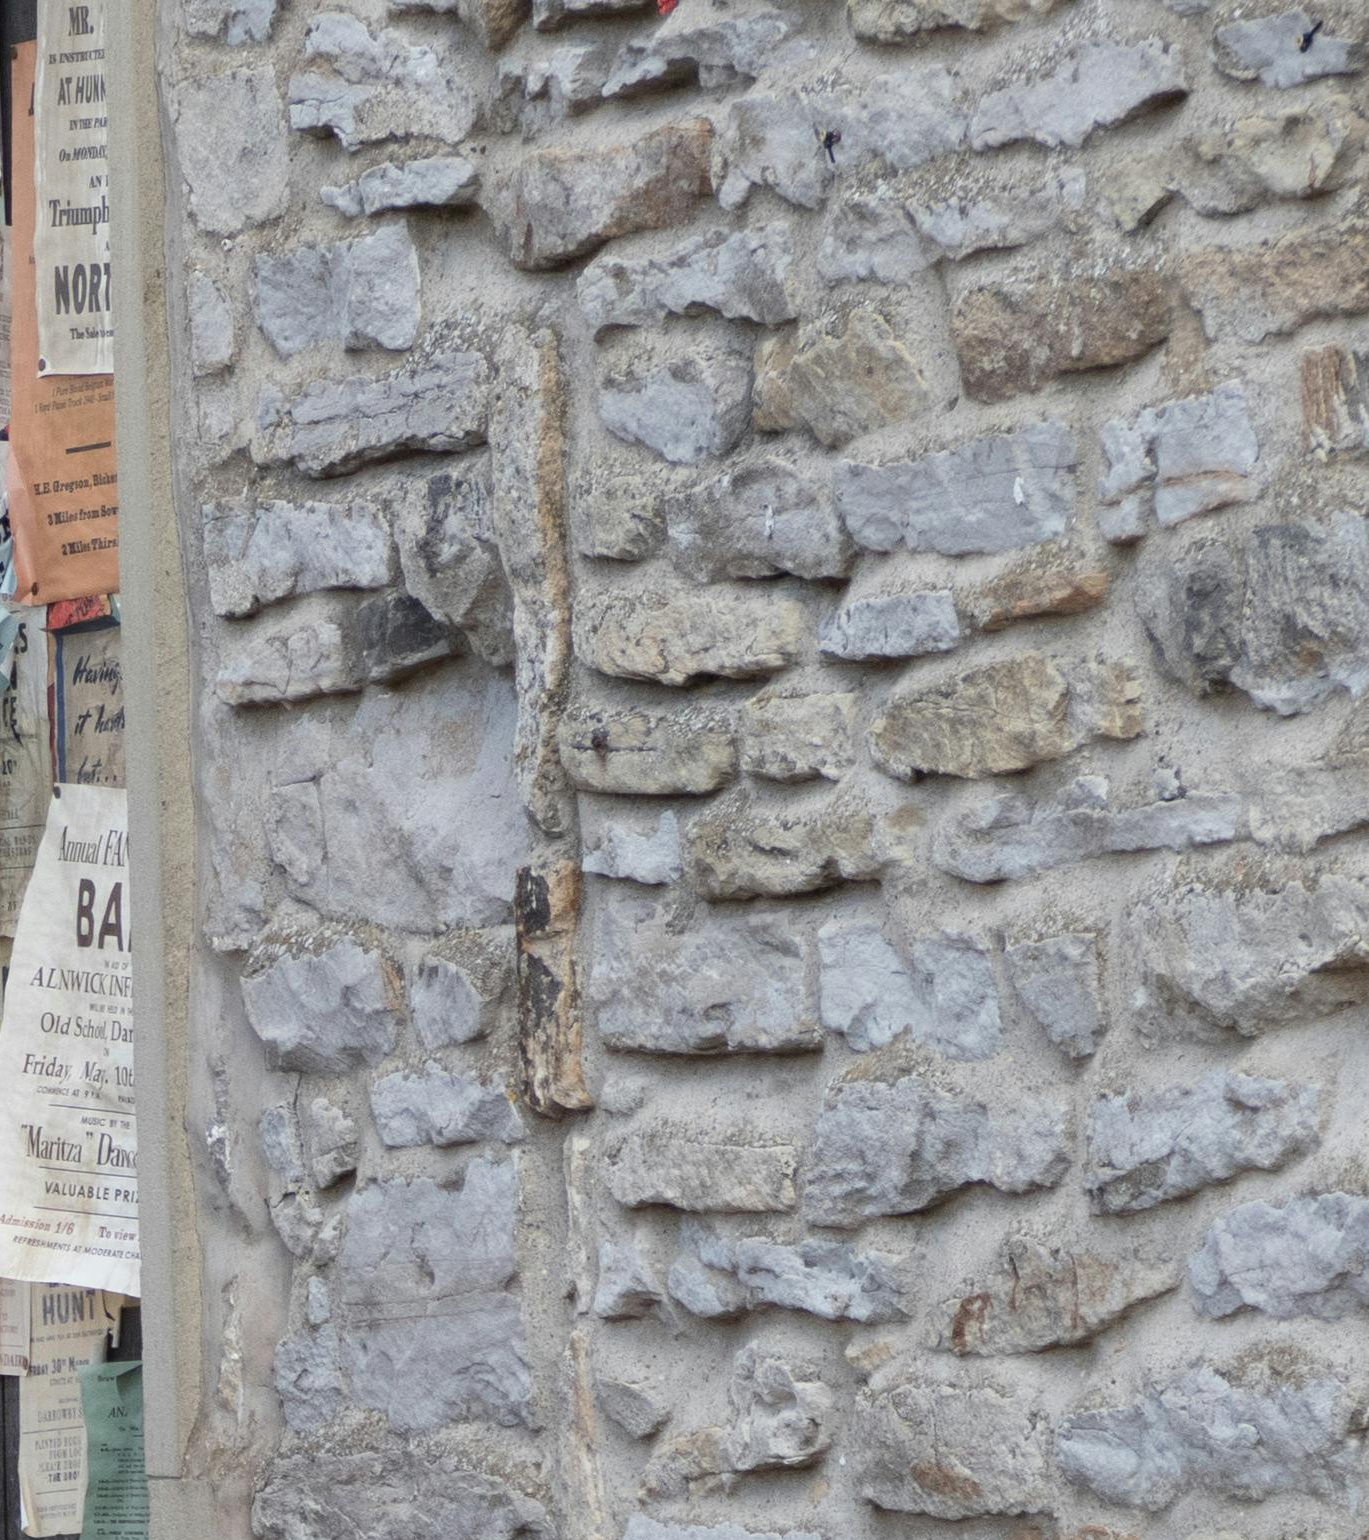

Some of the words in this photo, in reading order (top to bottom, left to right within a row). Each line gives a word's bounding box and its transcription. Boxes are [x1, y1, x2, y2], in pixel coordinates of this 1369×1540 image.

[68, 6, 94, 36] MR.
[48, 53, 57, 65] IS
[58, 77, 73, 106] AT
[48, 195, 110, 235] Triumph
[69, 327, 85, 340] The
[85, 326, 99, 339] Sale
[47, 514, 54, 526] 3
[54, 510, 78, 525] Miles
[79, 508, 100, 521] from
[62, 544, 68, 556] 2
[69, 540, 91, 555] Miles
[58, 825, 103, 865] Annual
[29, 966, 108, 996] ALNWICK
[40, 1011, 72, 1036] Old
[45, 1181, 110, 1201] VALUABLE
[54, 1219, 75, 1236] 1/6
[99, 1225, 112, 1239] To
[113, 1227, 137, 1241] view
[12, 1235, 72, 1252] REFRESHMENTS
[73, 1245, 83, 1254] AT
[83, 1246, 124, 1259] MODERATE
[42, 1288, 96, 1327] HUNT
